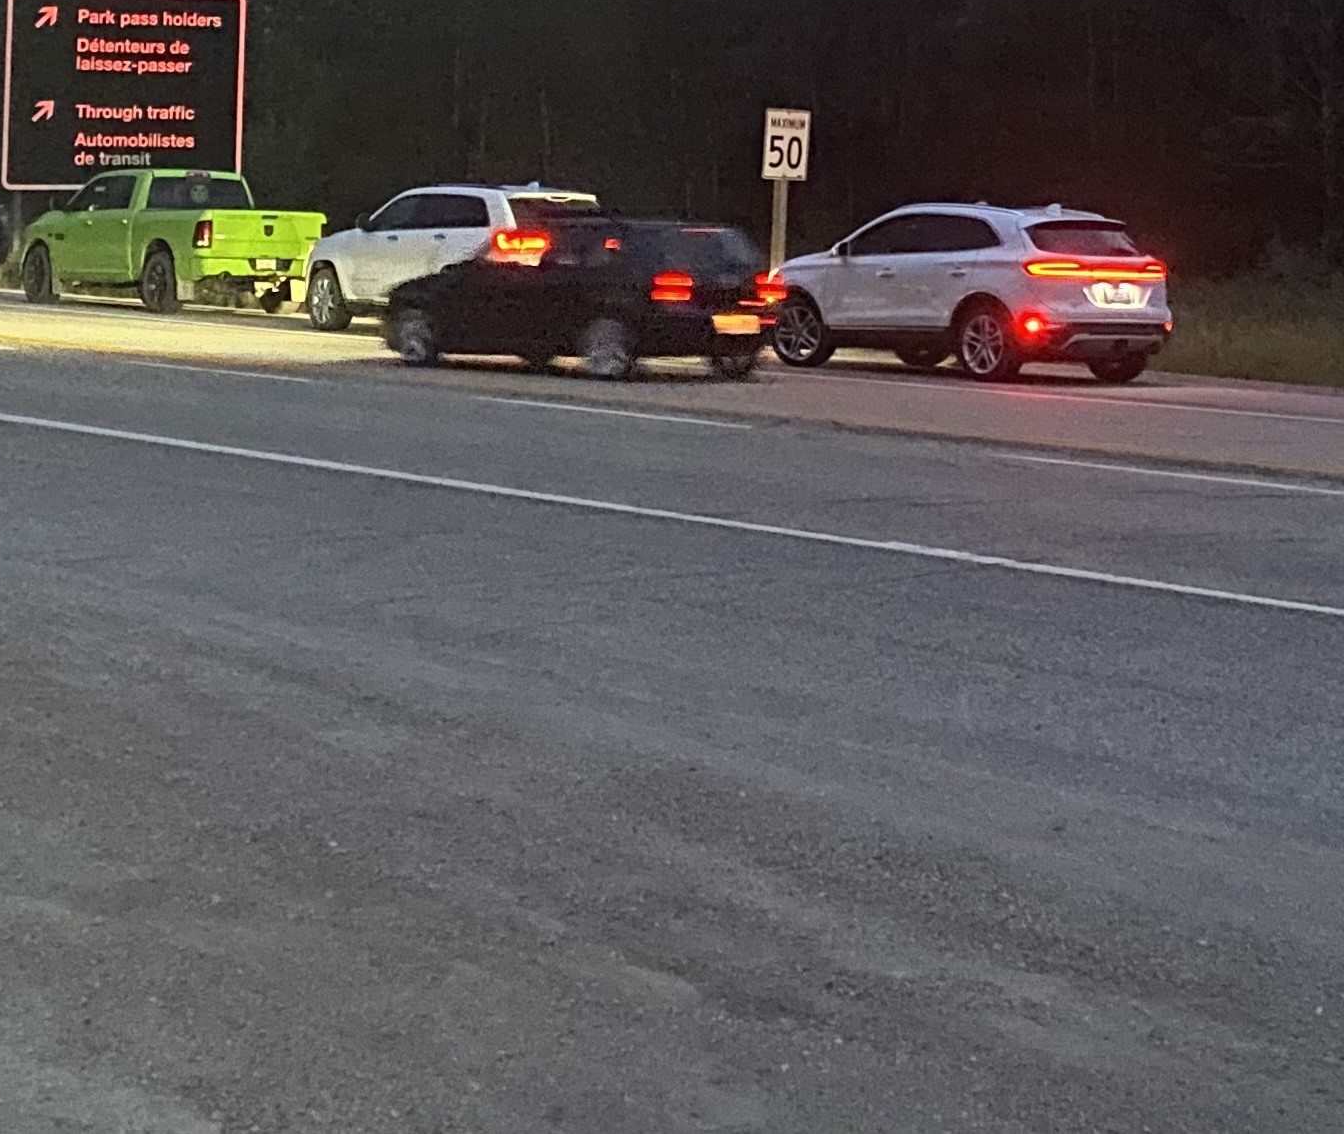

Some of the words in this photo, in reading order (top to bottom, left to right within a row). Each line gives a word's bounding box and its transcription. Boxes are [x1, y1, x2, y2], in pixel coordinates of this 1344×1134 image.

[77, 9, 116, 25] Park
[119, 12, 158, 28] pass
[162, 11, 222, 27] holders
[76, 37, 166, 54] Détenteurs
[169, 40, 190, 54] de
[76, 56, 192, 74] laissez-passer
[75, 104, 143, 122] Through
[146, 105, 195, 120] traffic
[771, 118, 805, 129] MAXIMUM
[74, 132, 195, 148] Automobilistes
[74, 151, 94, 165] de
[99, 152, 151, 165] transit
[769, 135, 802, 169] 50
